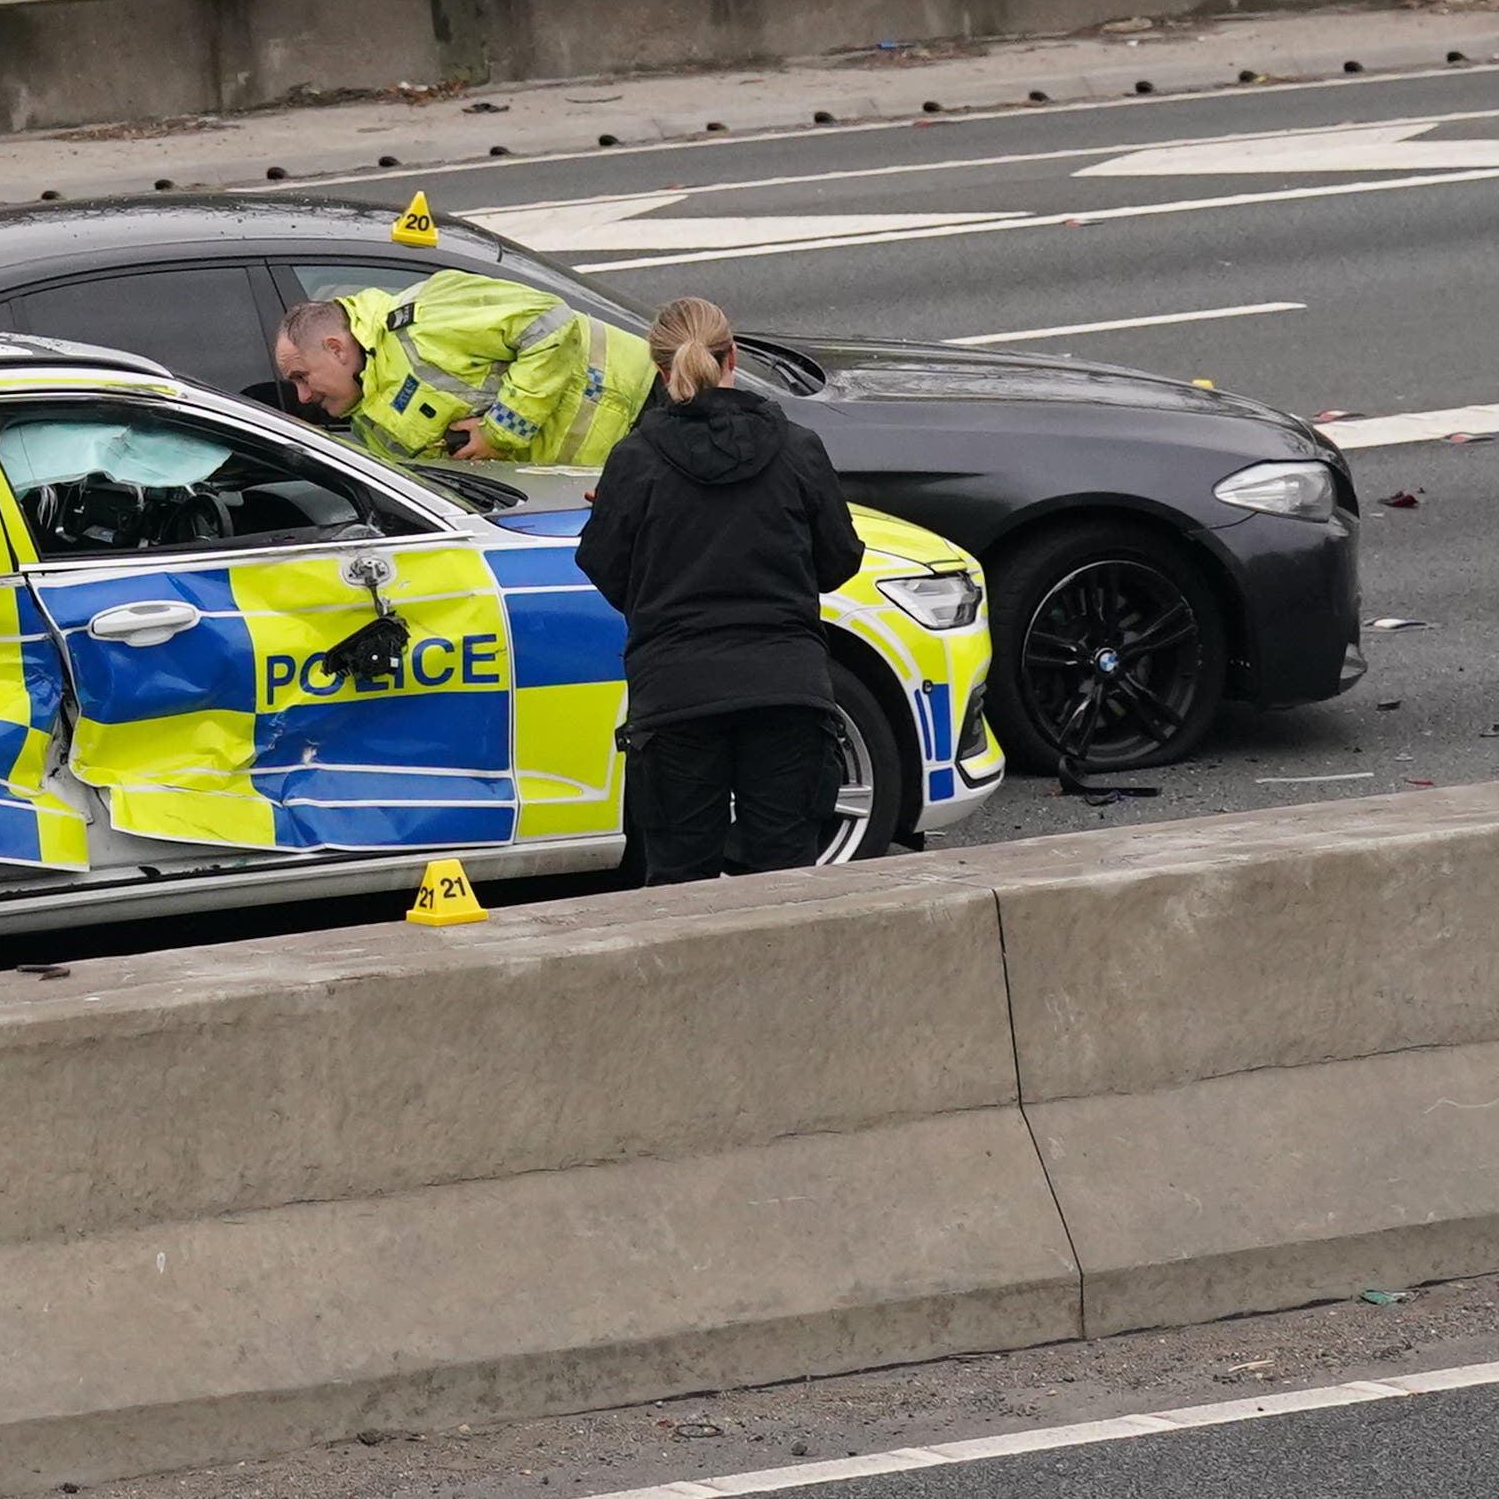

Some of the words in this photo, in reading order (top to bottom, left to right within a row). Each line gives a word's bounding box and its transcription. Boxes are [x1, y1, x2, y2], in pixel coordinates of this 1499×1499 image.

[405, 213, 430, 232] 20
[419, 886, 435, 910] 21
[440, 876, 467, 899] 21
